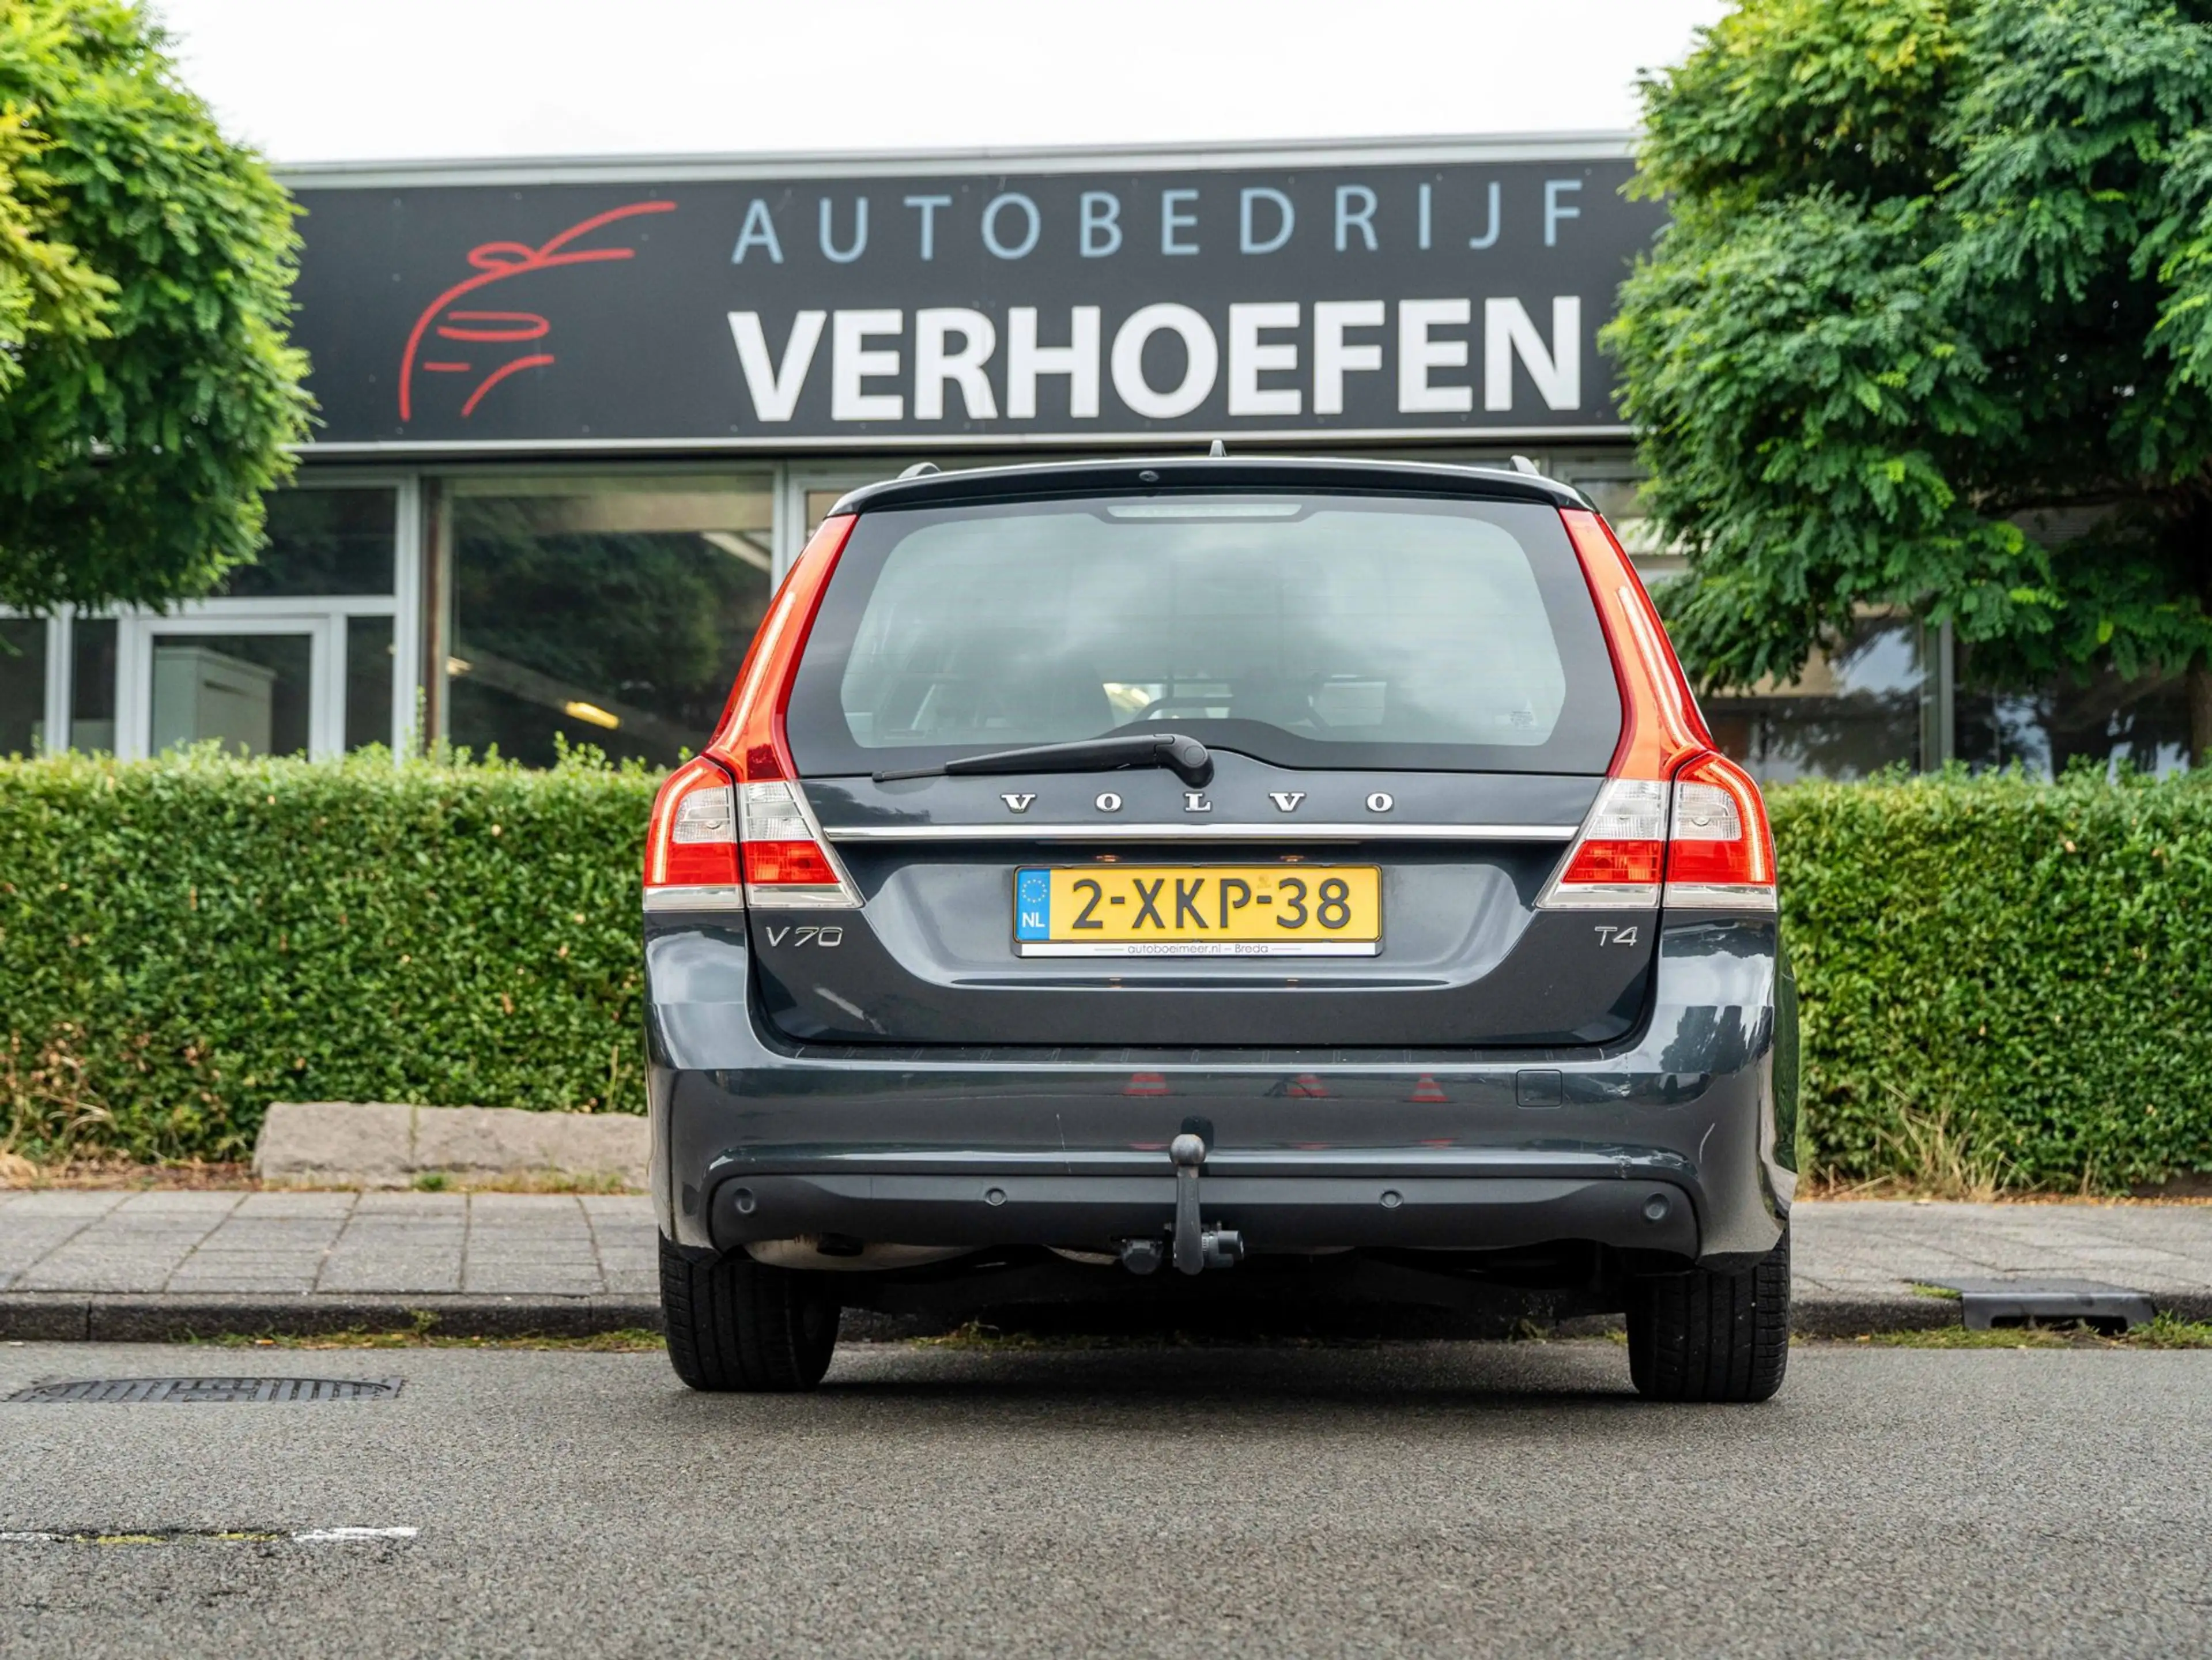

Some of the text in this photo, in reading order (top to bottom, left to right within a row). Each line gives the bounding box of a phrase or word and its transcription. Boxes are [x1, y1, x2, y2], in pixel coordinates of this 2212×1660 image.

[731, 179, 1583, 264] AUTOBEDRIJF
[727, 296, 1581, 422] VERHOEFEN
[1001, 792, 1393, 813] VOLVO
[1072, 878, 1350, 929] 2-XKP-38
[1022, 912, 1045, 927] NL
[1595, 926, 1637, 946] T4
[1235, 944, 1269, 953] Breda
